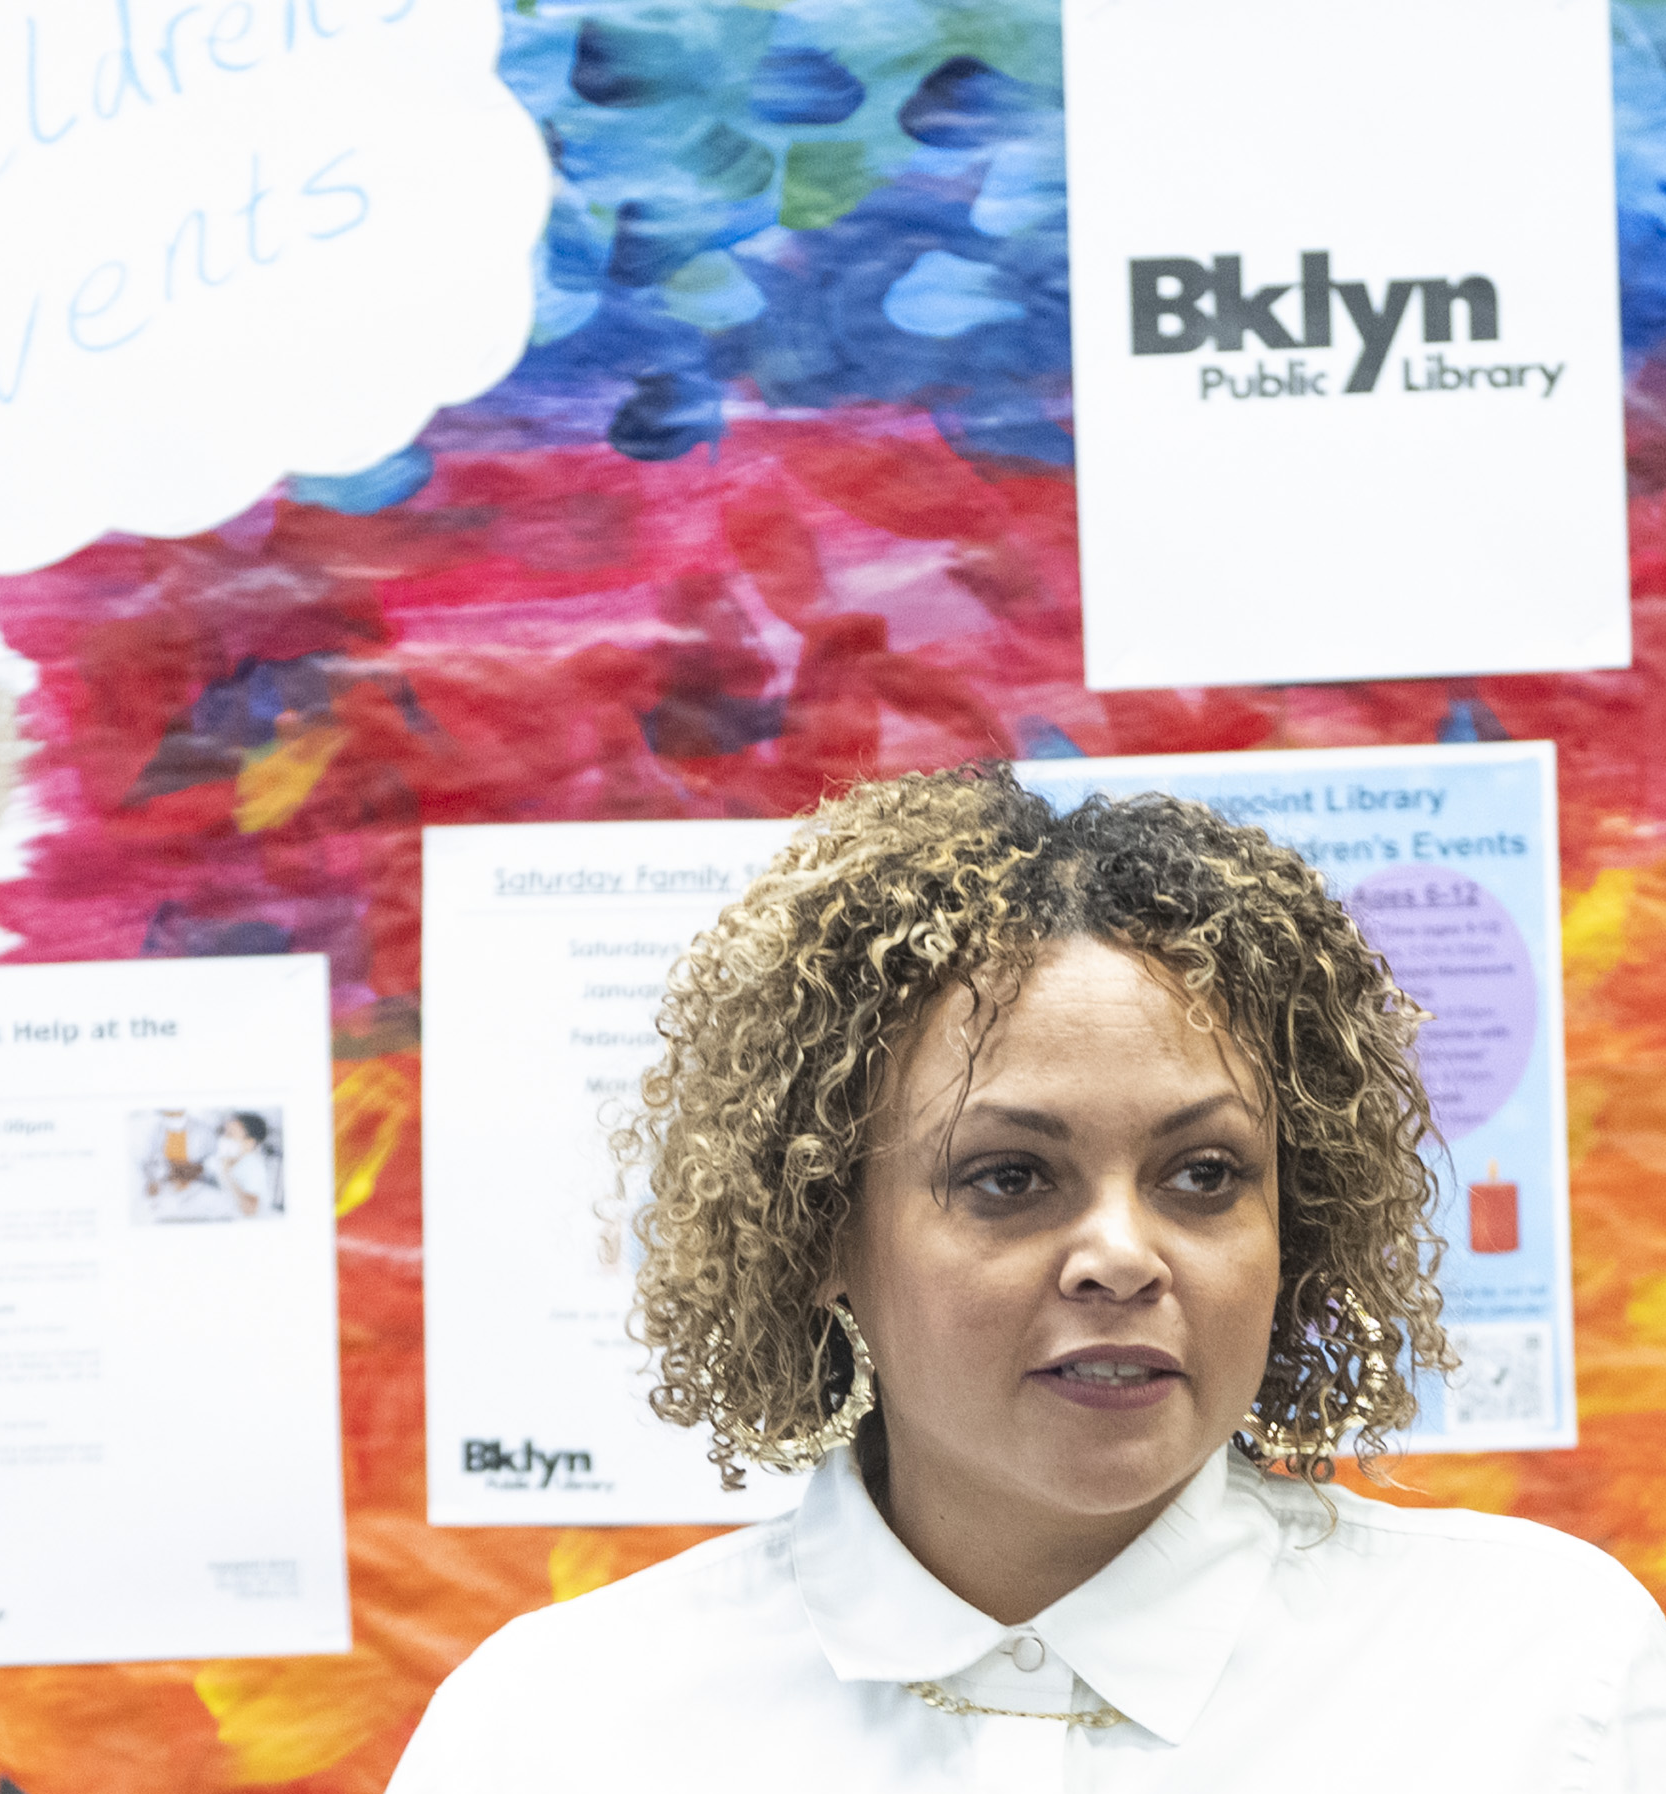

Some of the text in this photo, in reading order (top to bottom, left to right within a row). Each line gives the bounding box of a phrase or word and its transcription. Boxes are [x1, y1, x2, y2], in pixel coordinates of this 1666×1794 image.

[1129, 251, 1498, 393] Bklyn
[1200, 352, 1565, 400] Public Library
[1325, 785, 1445, 816] Library
[1413, 831, 1527, 859] Events
[494, 868, 622, 892] Saturday
[637, 864, 729, 891] Family
[583, 980, 666, 1000] Januar
[13, 1019, 81, 1047] Help
[90, 1018, 119, 1042] at
[129, 1016, 178, 1039] the
[569, 1028, 660, 1047] Februar
[461, 1437, 594, 1489] Bklyn
